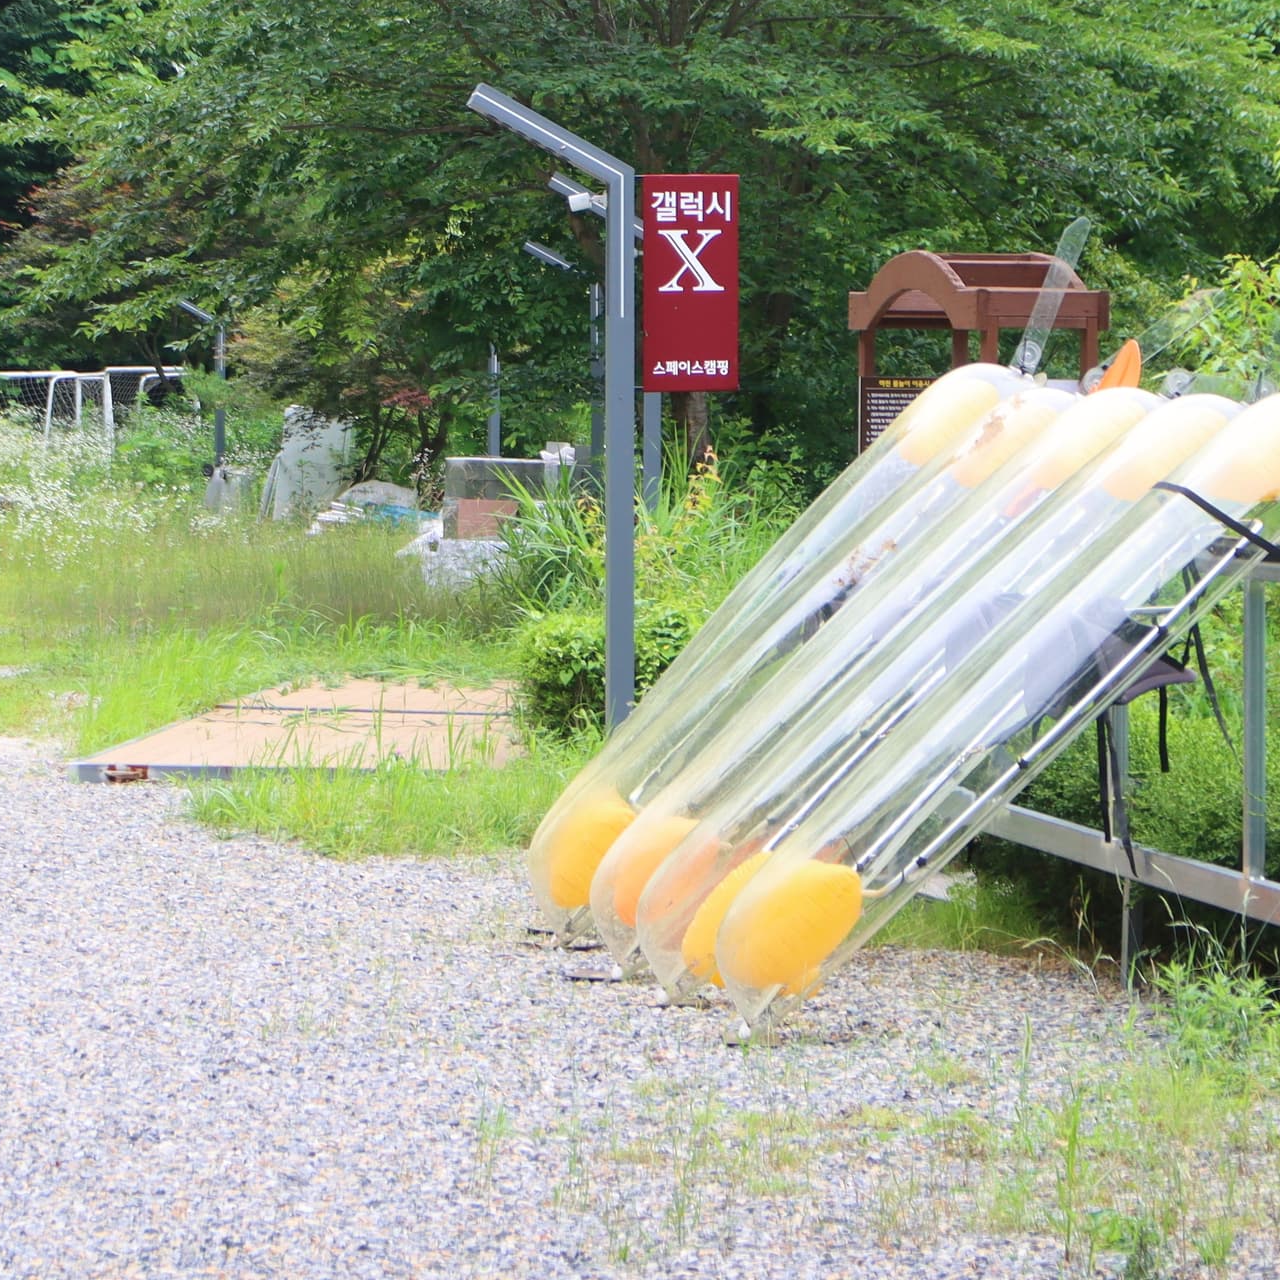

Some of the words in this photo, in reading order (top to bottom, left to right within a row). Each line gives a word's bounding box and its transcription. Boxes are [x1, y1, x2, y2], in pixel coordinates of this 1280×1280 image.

[651, 191, 731, 221] 갤럭시
[658, 229, 724, 291] X
[653, 360, 728, 375] 스페이스캠핑
